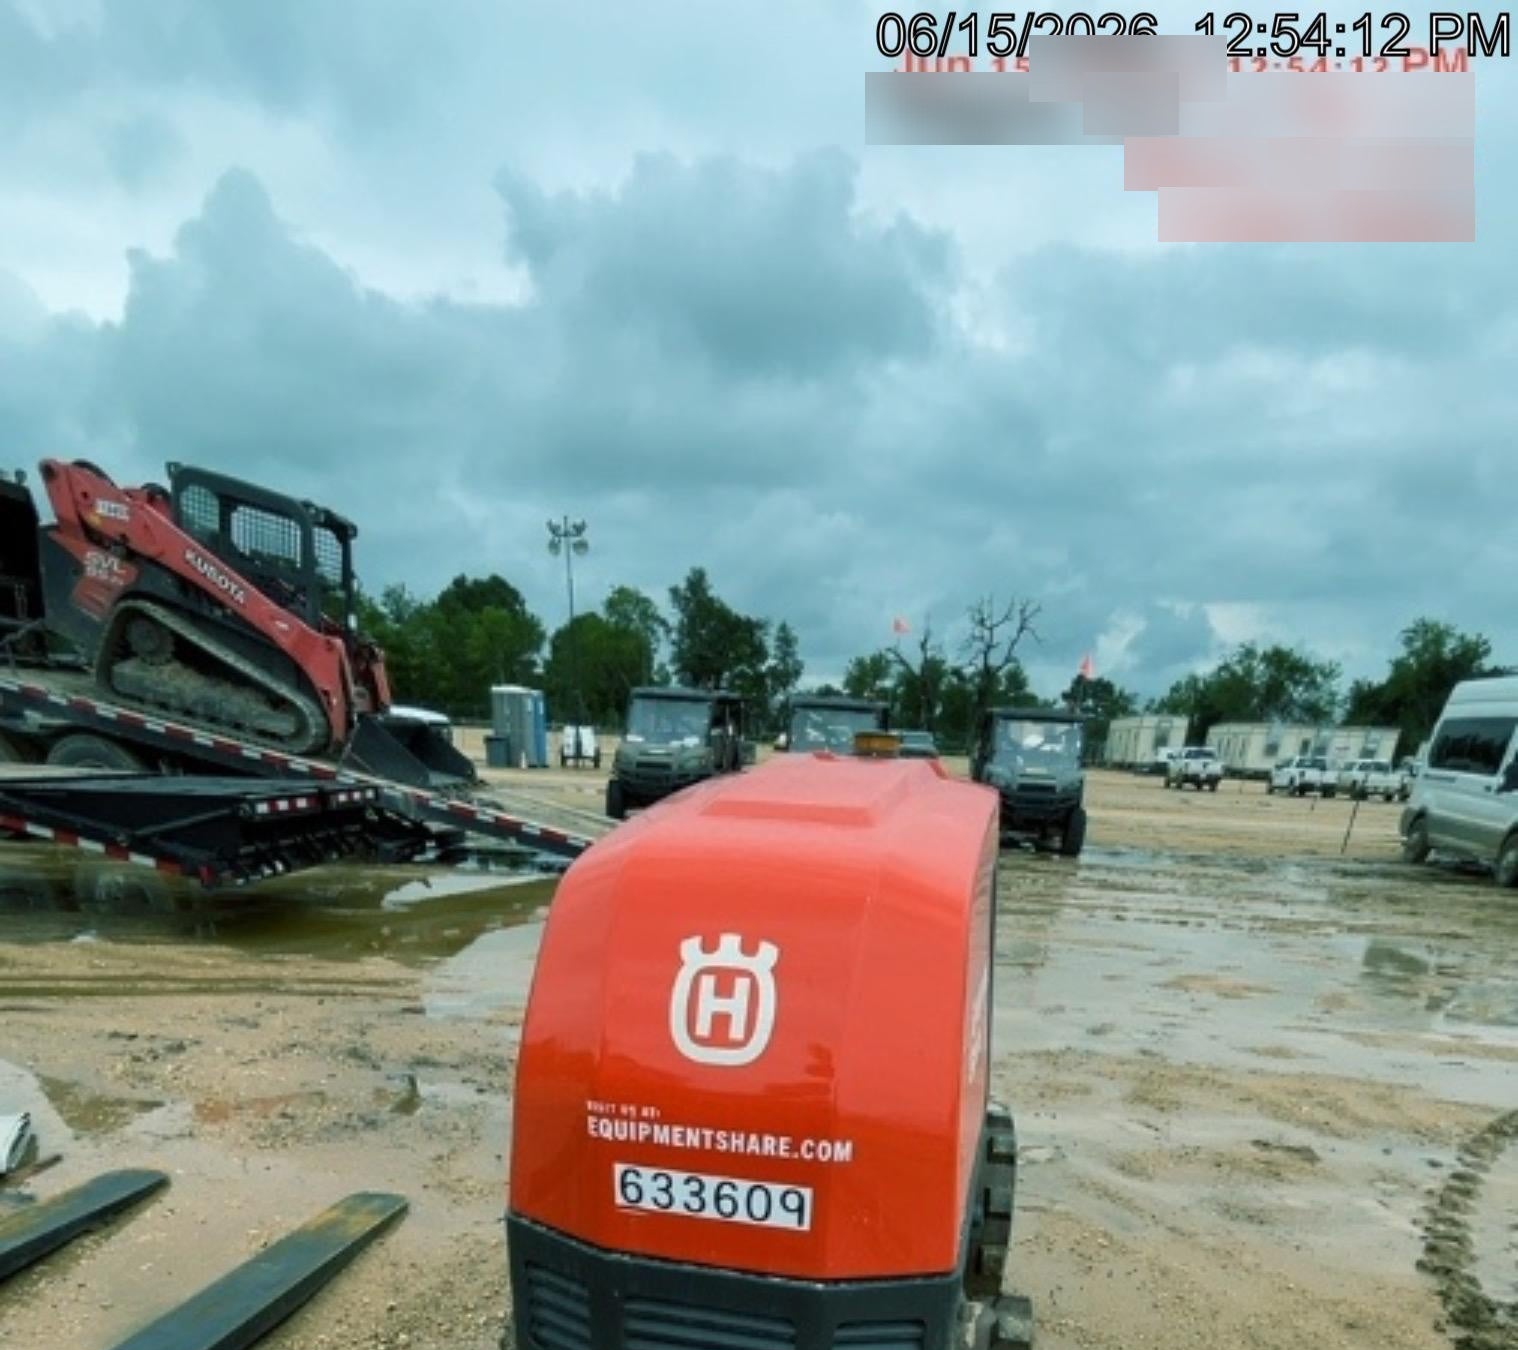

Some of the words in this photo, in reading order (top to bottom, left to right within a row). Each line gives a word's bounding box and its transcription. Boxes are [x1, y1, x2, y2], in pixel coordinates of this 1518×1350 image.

[185, 549, 245, 604] KUBOTA
[695, 973, 752, 1041] H
[586, 1115, 854, 1163] EQUIPMENTSHARE.COM
[619, 1168, 806, 1228] 633609
